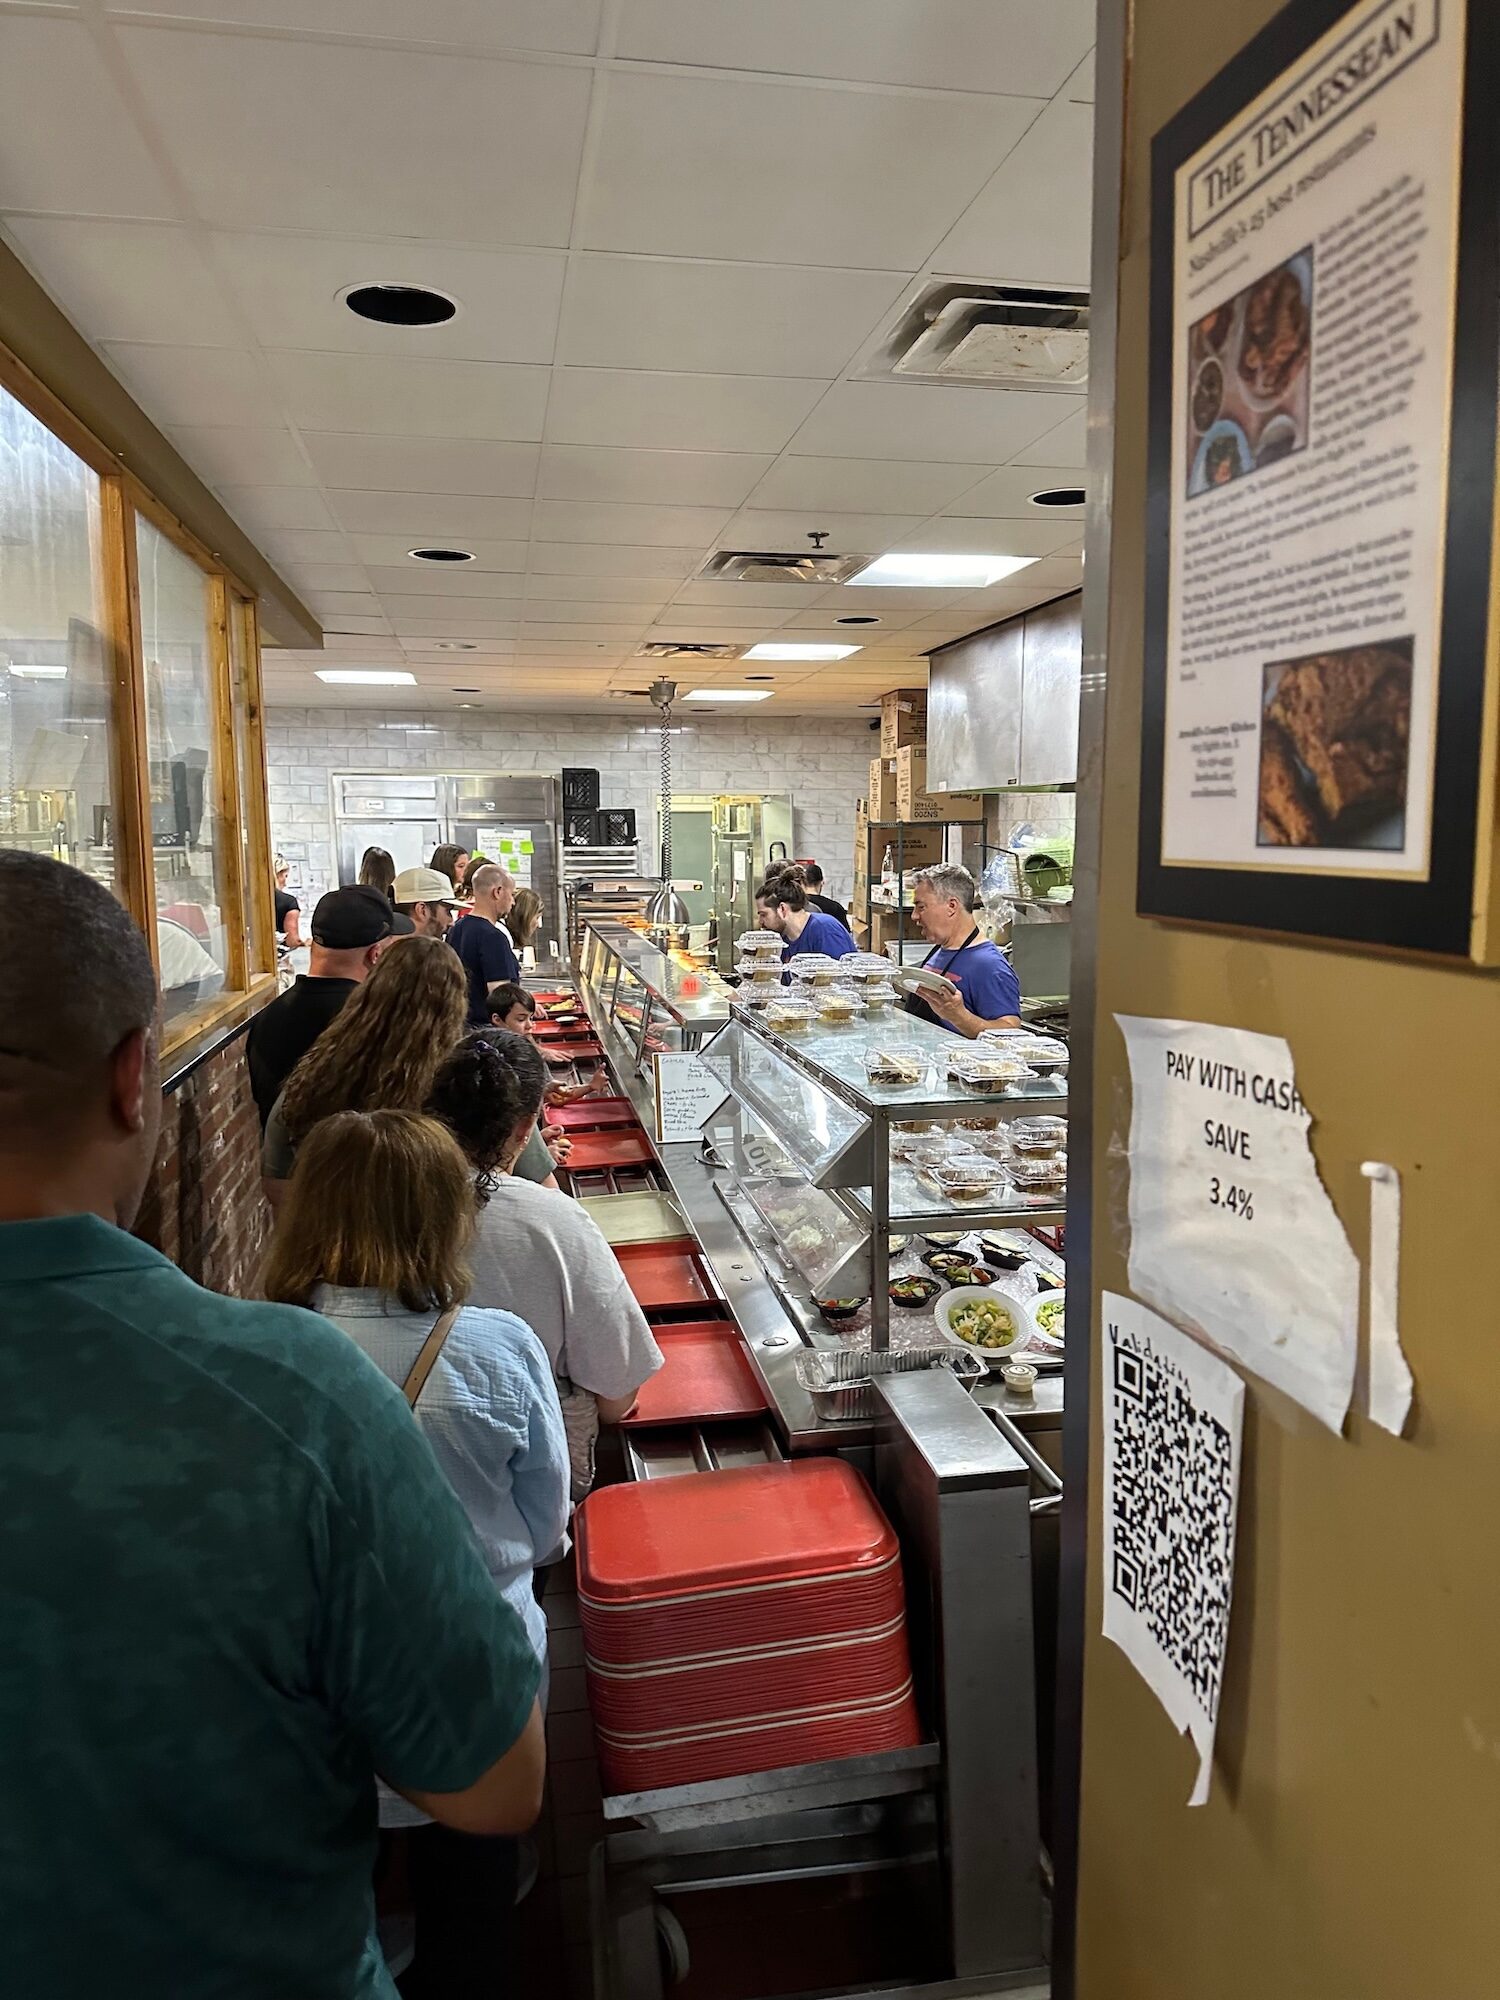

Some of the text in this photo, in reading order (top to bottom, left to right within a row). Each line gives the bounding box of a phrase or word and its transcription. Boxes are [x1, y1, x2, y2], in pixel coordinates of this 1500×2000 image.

[1204, 2, 1416, 209] THE TENNESSEAN
[1266, 184, 1293, 219] best
[914, 810, 939, 819] SN200
[1166, 1050, 1195, 1081] PAY
[1200, 1058, 1246, 1098] WITH
[1204, 1119, 1252, 1160] SAVE
[1209, 1177, 1254, 1221] 3.4%
[1108, 1323, 1192, 1393] Validation
